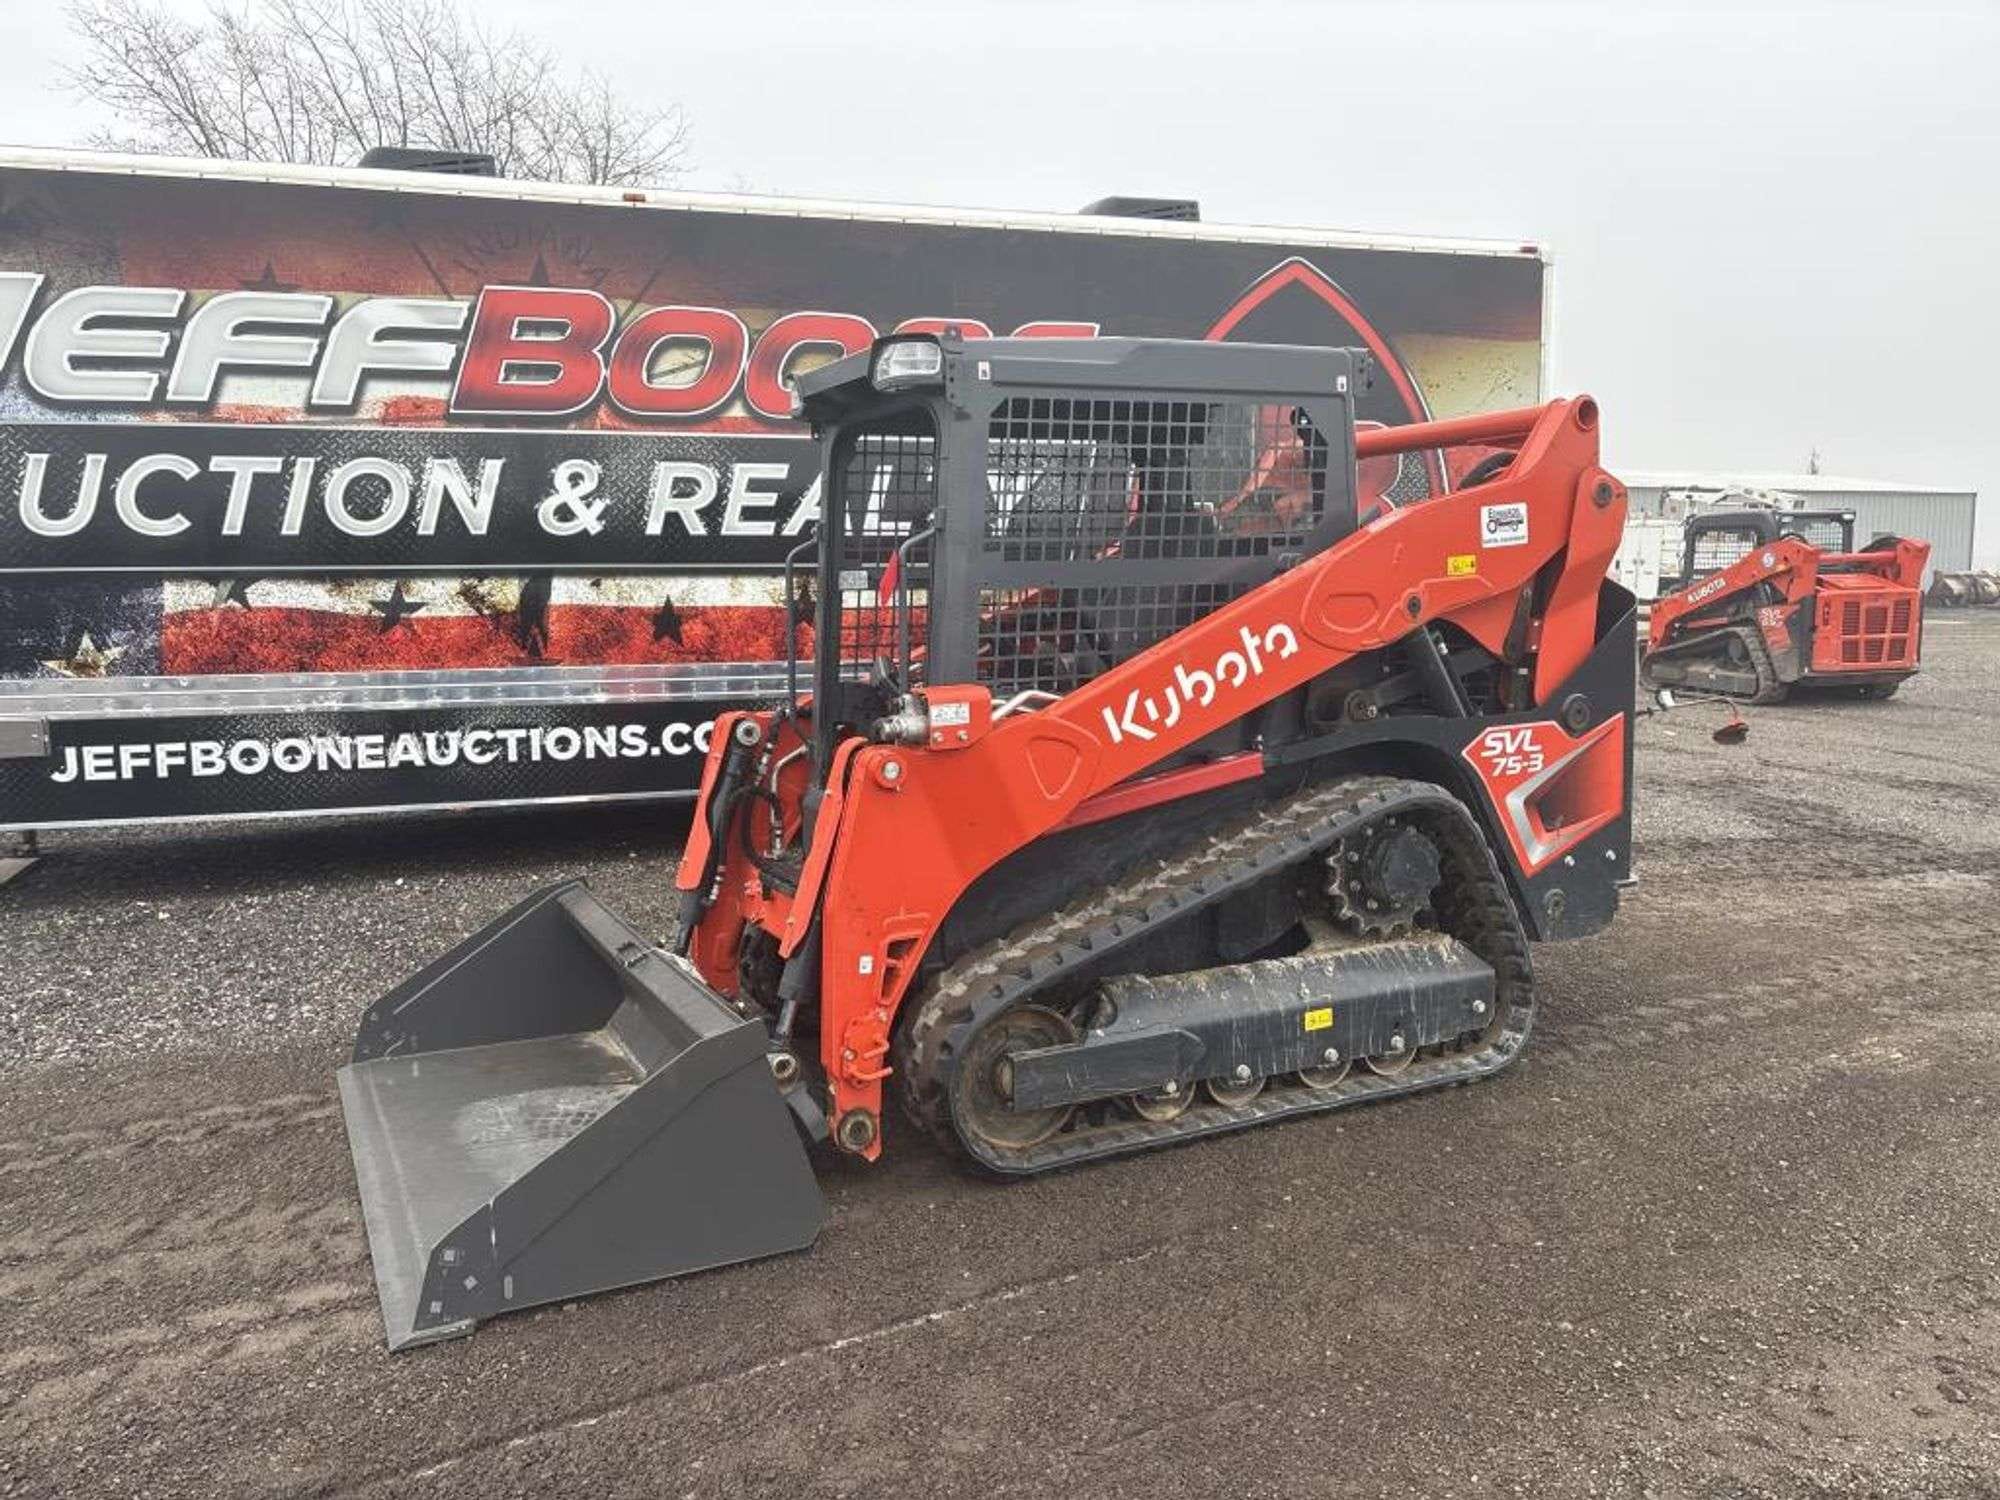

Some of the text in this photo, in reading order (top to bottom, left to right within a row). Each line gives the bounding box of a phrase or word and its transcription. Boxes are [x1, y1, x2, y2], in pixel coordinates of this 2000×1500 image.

[0, 271, 1099, 418] EFFBOO
[19, 452, 1045, 537] UCTION & REALY
[1102, 623, 1299, 744] Kubota
[50, 720, 716, 783] JEFFBOONEAUCTIONS.CO
[1480, 729, 1543, 758] SVL
[1491, 753, 1545, 777] 75-3
